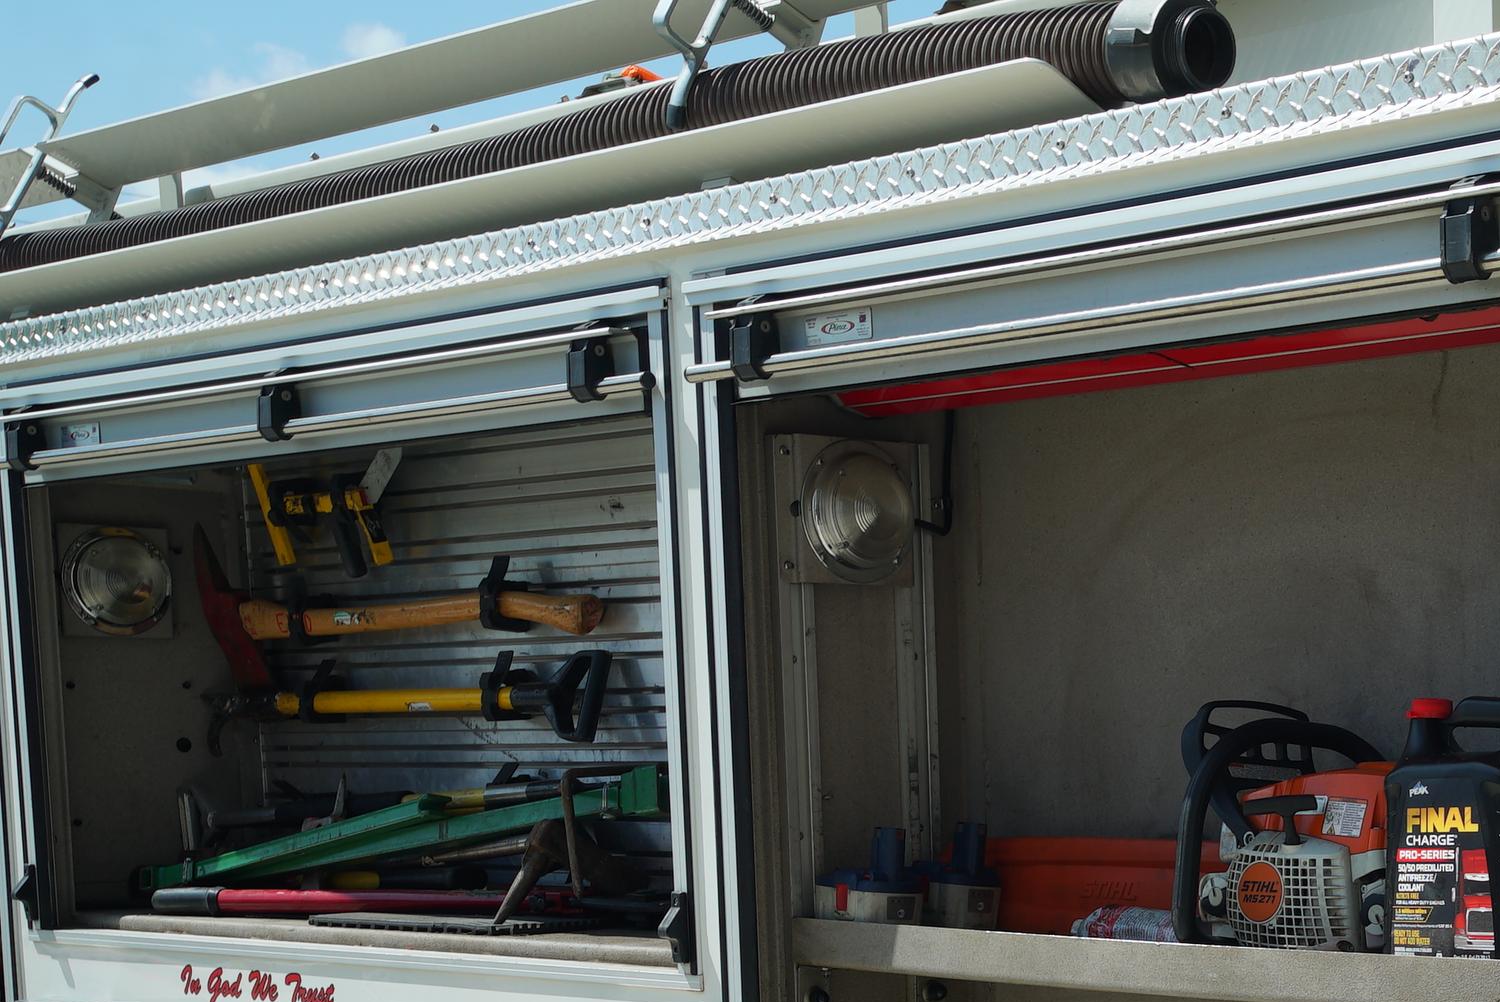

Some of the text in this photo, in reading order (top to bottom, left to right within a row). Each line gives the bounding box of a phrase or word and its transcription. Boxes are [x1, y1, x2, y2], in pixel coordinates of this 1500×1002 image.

[1409, 786, 1429, 798] PEAK
[1406, 806, 1479, 833] FINAL
[1399, 850, 1455, 860] PRO-SERIES
[1398, 863, 1455, 873] 50/50 PREDILUTED
[1081, 880, 1137, 901] STIHL
[1241, 881, 1278, 893] STIHL
[1398, 883, 1425, 892] COOLANT
[180, 964, 202, 995] In
[248, 969, 279, 1002] We
